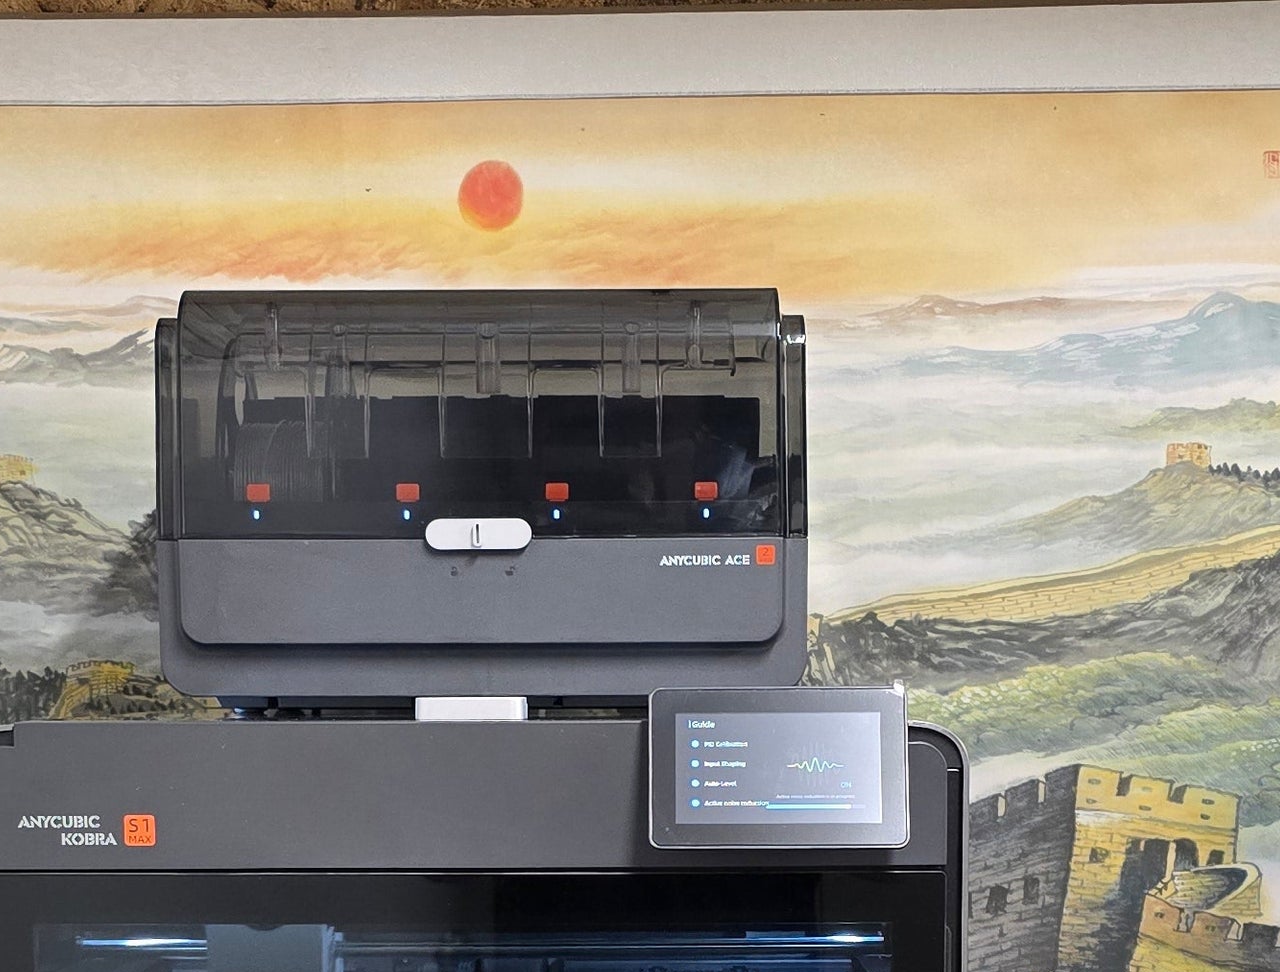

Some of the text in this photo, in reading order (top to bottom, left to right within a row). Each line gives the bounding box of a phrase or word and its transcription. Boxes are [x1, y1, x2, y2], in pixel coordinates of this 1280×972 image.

[659, 554, 721, 567] ANYCUBIC
[725, 554, 751, 566] ACE
[17, 814, 101, 829] ANYCUBIC
[60, 832, 118, 846] KOBRA
[128, 835, 153, 844] MAX
